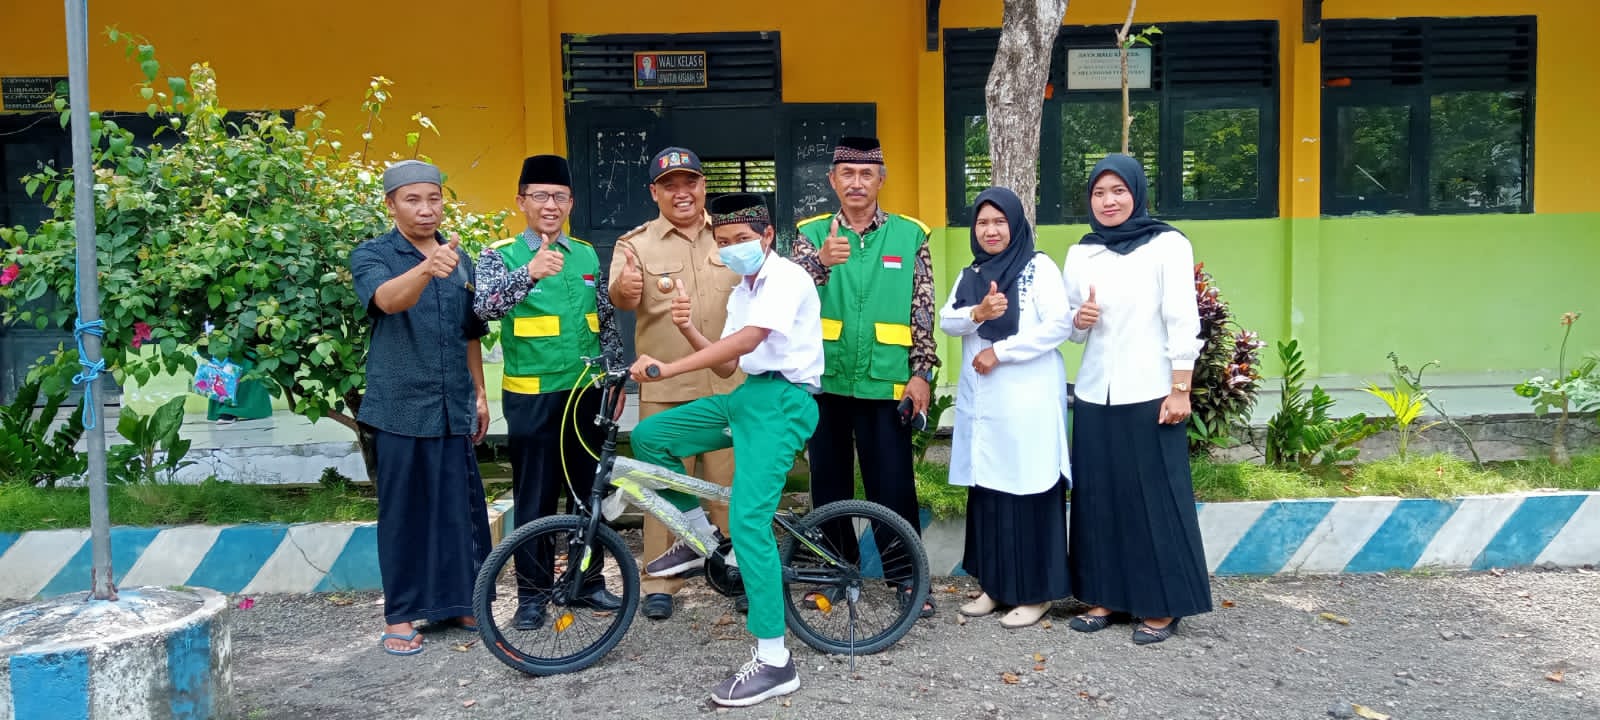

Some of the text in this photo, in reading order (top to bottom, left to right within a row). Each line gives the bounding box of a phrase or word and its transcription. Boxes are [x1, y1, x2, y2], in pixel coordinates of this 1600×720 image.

[658, 55, 703, 68] WALI KELAS 6
